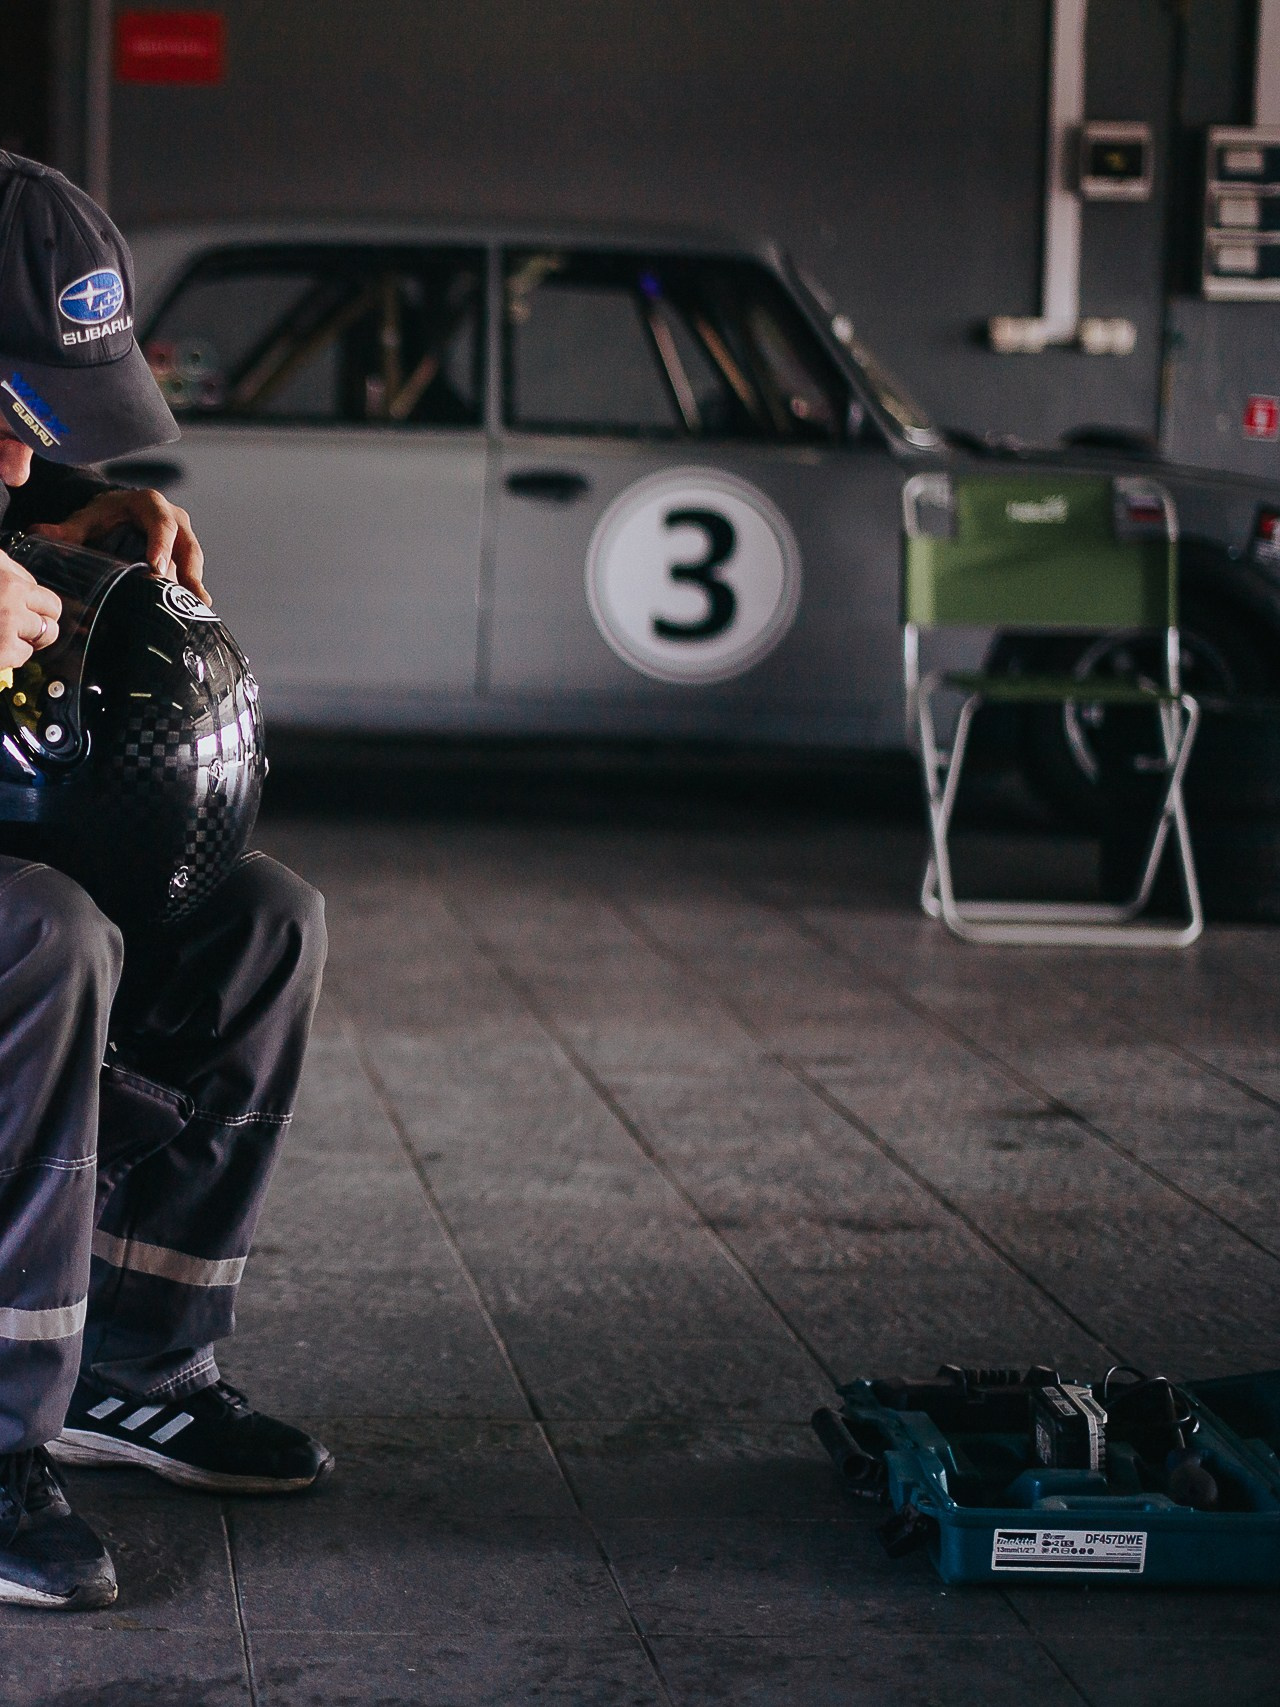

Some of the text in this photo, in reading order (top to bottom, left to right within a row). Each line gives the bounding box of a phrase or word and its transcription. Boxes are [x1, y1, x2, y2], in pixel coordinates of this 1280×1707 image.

[62, 315, 131, 346] SUBARU
[12, 401, 54, 447] SUBARU
[653, 505, 737, 641] 3
[997, 1537, 1037, 1546] makita
[1085, 1534, 1144, 1545] DF457DWE
